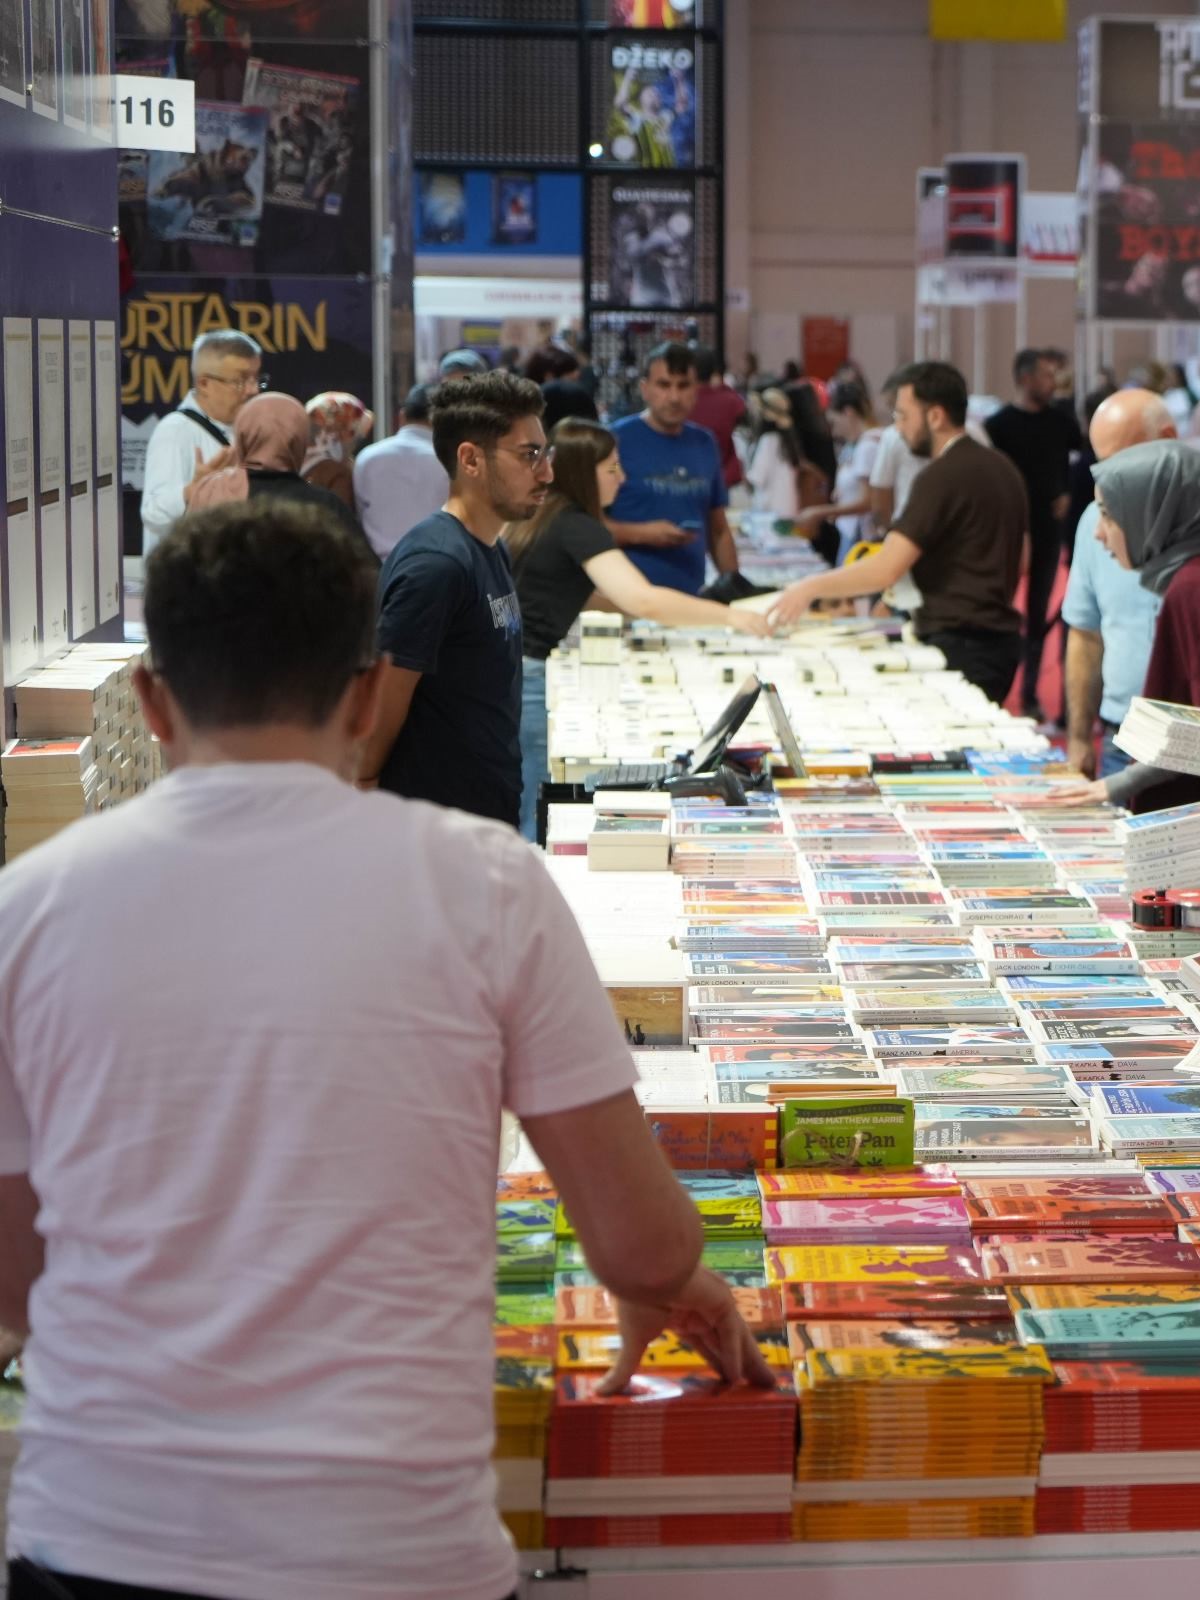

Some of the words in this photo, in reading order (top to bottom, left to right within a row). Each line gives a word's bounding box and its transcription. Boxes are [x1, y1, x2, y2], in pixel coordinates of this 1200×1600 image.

[612, 43, 694, 69] DŽEKO
[112, 96, 175, 128] 116
[861, 1131, 896, 1148] Pan
